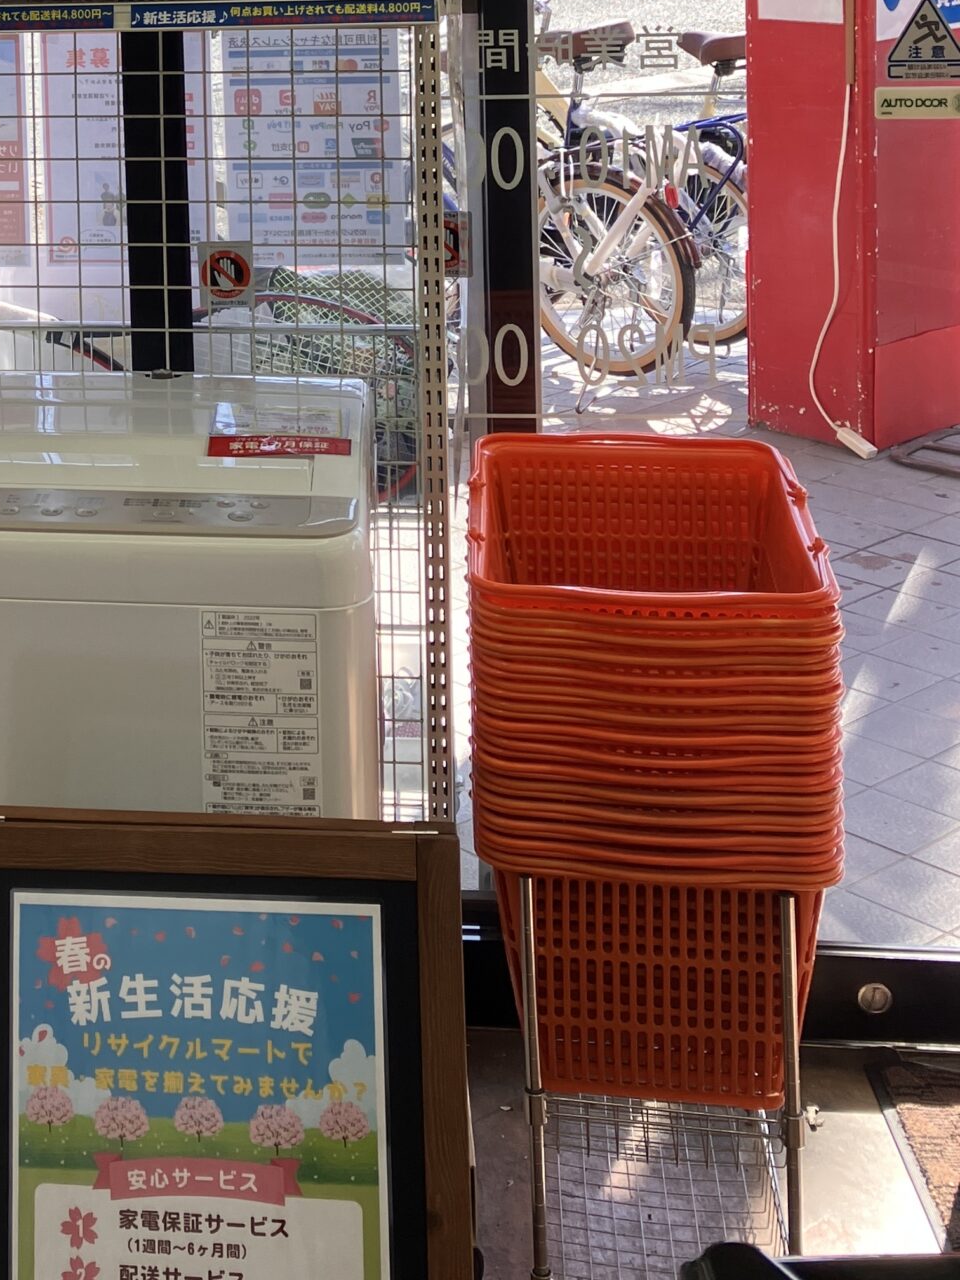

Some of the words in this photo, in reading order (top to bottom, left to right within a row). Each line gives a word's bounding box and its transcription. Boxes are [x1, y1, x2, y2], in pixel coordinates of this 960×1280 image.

[143, 10, 215, 25] 新生活応援
[908, 46, 945, 58] 注意
[881, 99, 913, 107] AUTO
[915, 98, 948, 107] DOOR
[54, 936, 112, 974] 春の
[67, 974, 319, 1037] 新生活応援
[83, 1032, 312, 1066] リサイクルマートで
[127, 1168, 258, 1193] 安心サービス
[118, 1209, 289, 1238] 家電保証サービス
